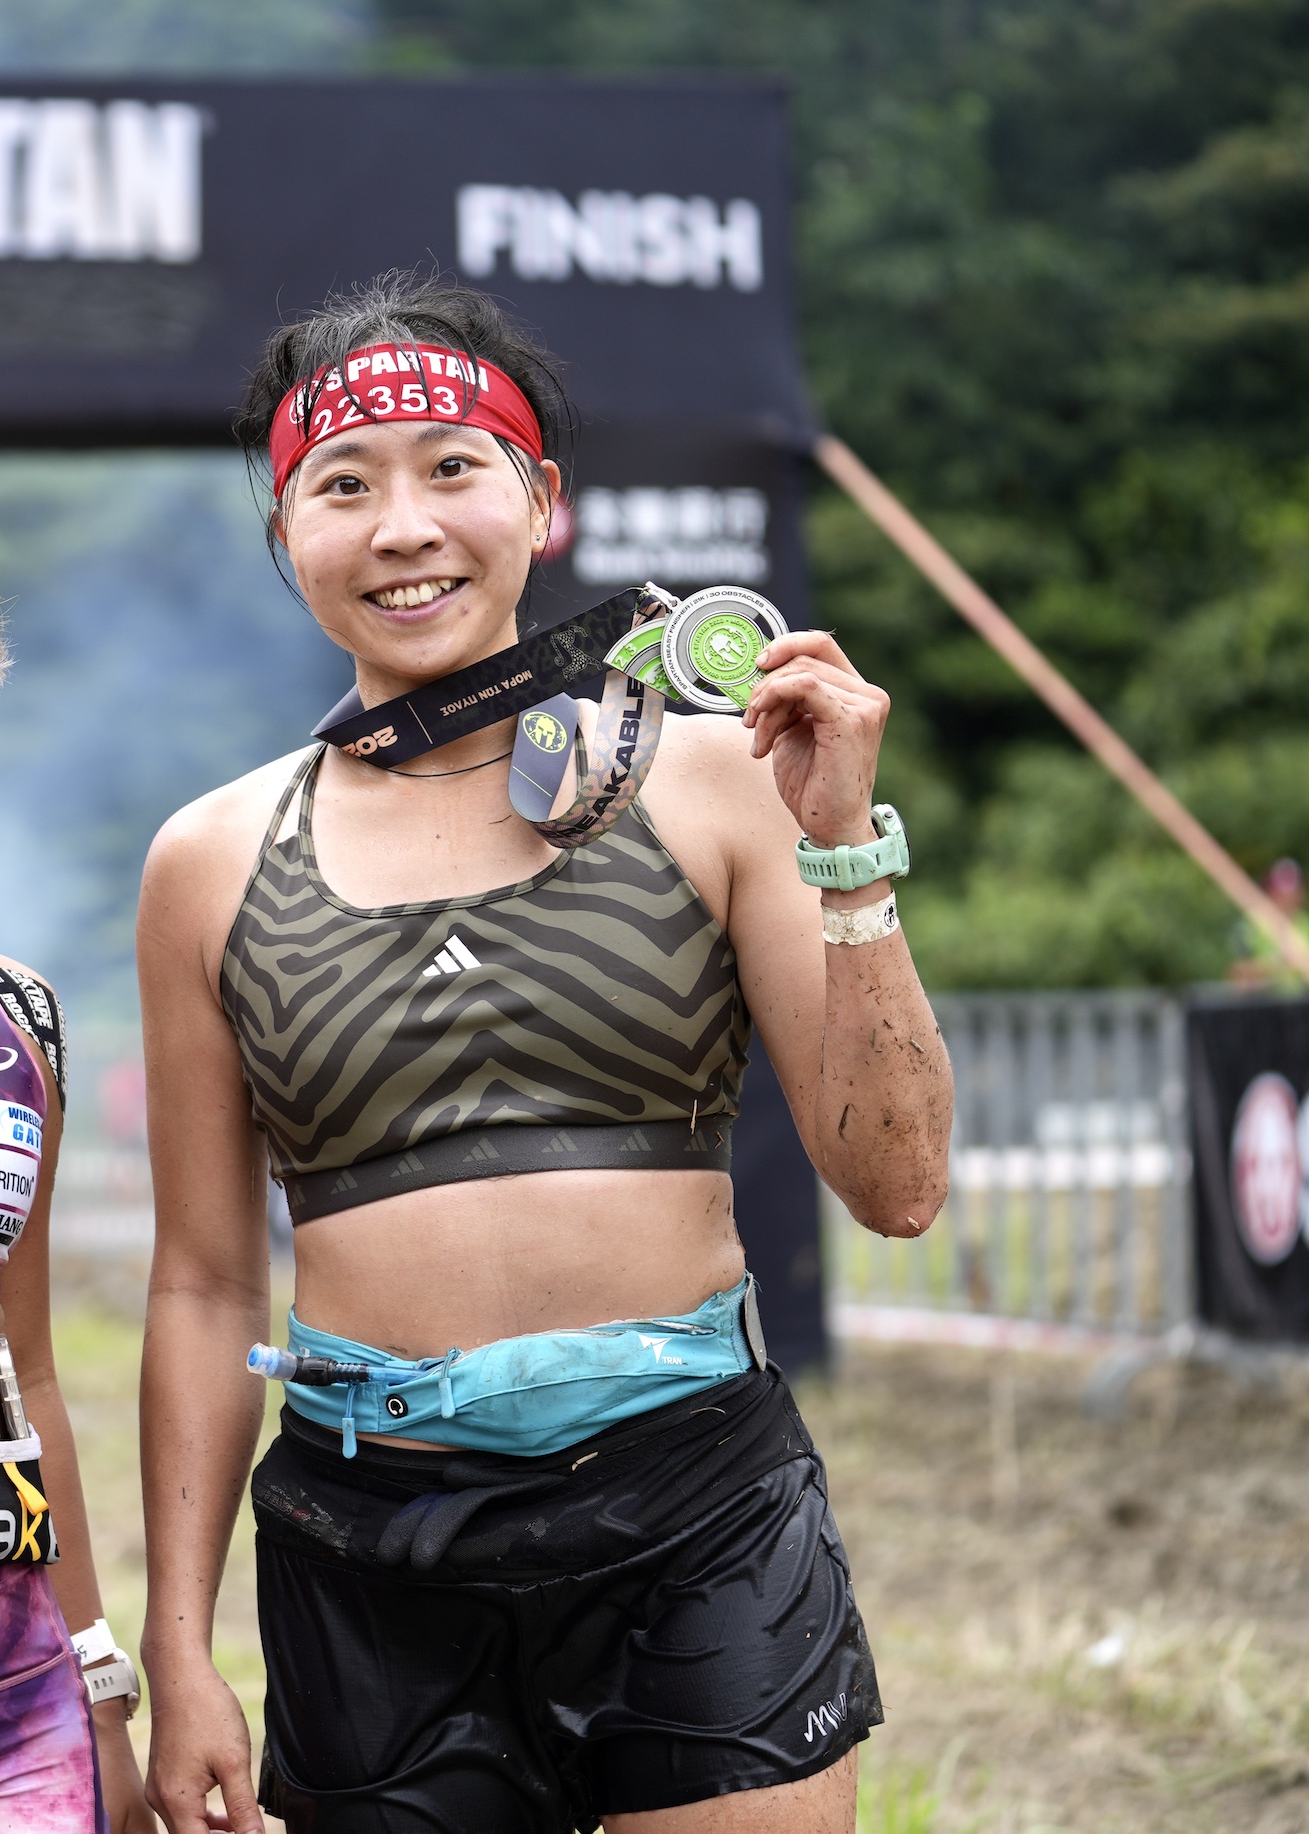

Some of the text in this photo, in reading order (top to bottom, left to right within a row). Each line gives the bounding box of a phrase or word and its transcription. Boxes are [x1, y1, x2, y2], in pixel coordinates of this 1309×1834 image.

[456, 183, 765, 292] FINISH
[325, 351, 490, 392] SPARTAN
[314, 383, 459, 441] 22353
[721, 590, 765, 608] OBSTACLES
[670, 605, 691, 633] FINISHER
[667, 661, 688, 690] SPARTAN
[12, 1123, 41, 1149] GAT
